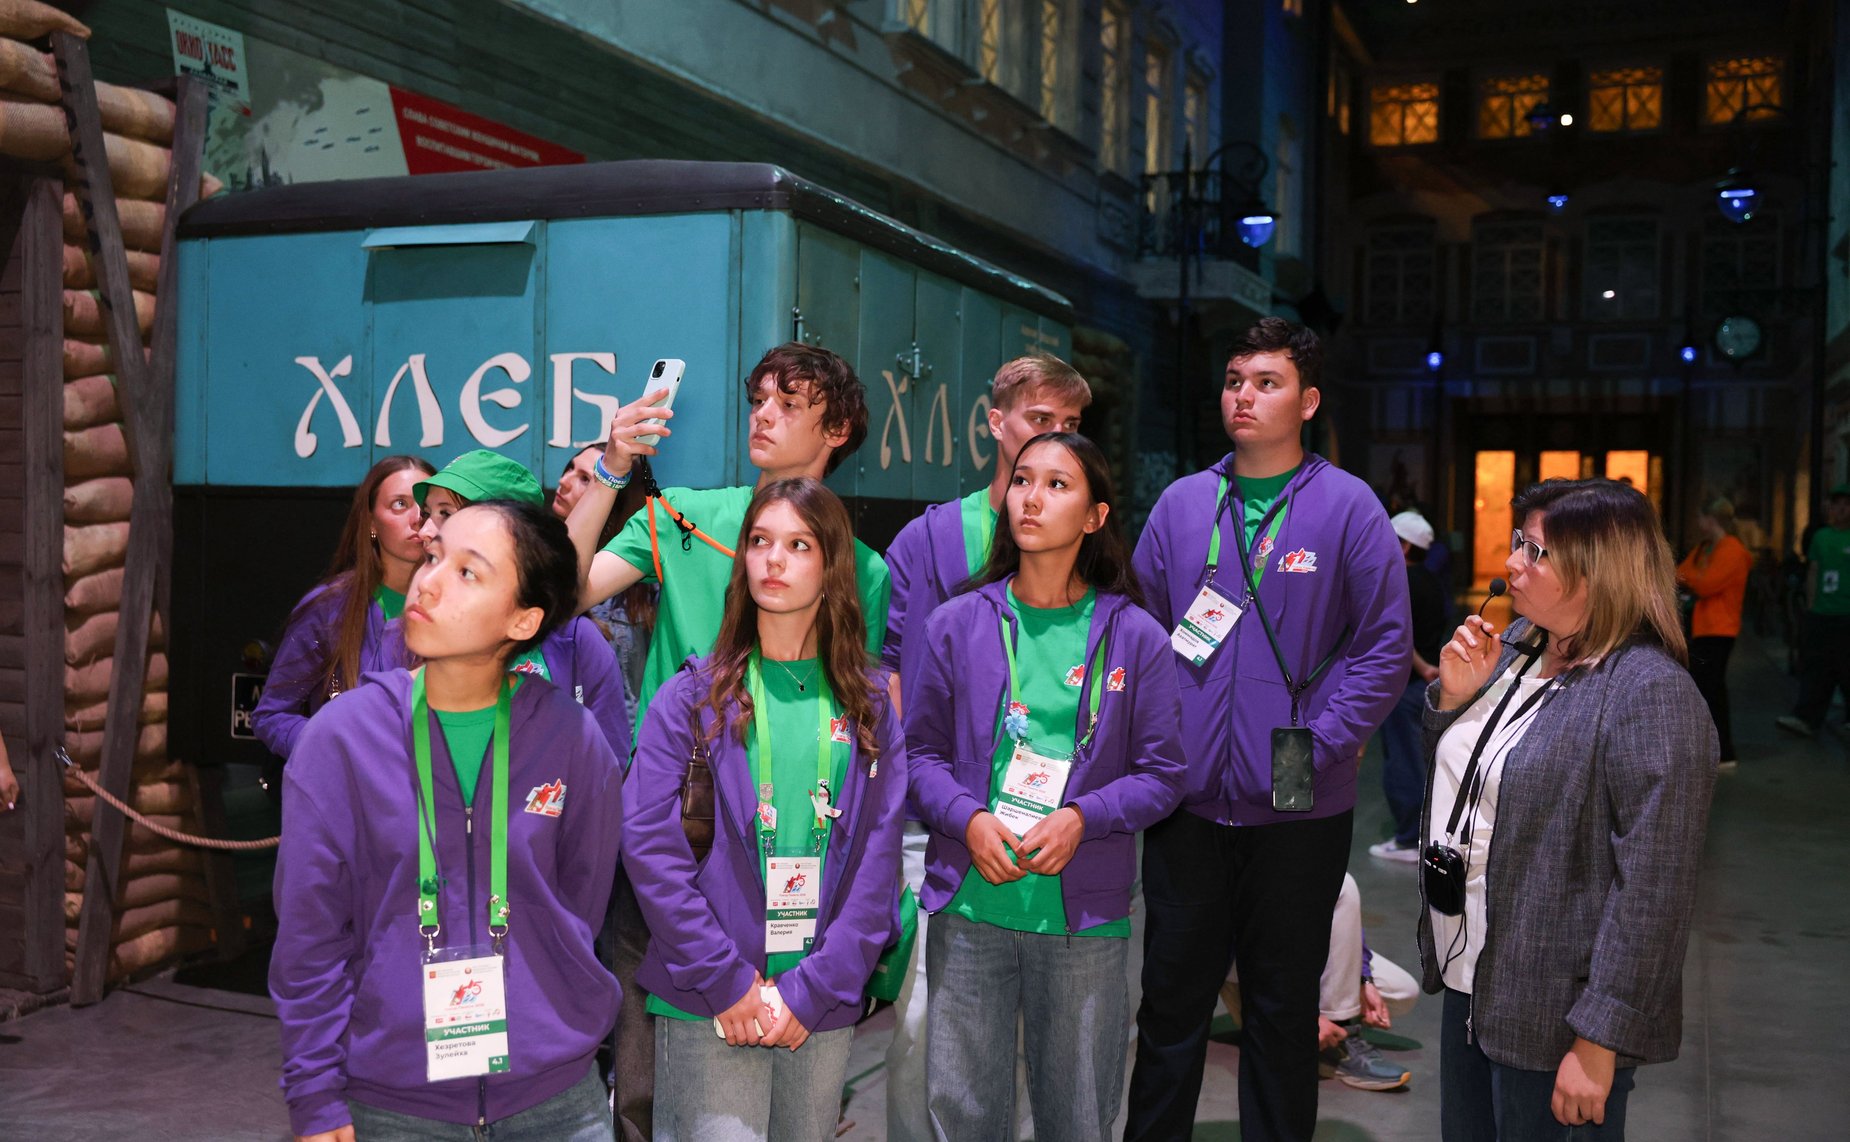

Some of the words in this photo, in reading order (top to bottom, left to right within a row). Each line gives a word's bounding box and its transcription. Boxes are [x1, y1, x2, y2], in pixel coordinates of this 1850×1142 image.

[175, 30, 204, 61] ОКНО
[294, 352, 620, 459] ХЛЕБ
[880, 370, 992, 471] ХЛЕ
[1011, 796, 1044, 812] УЧАСТНИК
[777, 910, 808, 918] УЧАСТНИК
[443, 1023, 490, 1036] УЧАСТНИК
[434, 1040, 476, 1052] Хезретова
[434, 1050, 468, 1061] Зулейка
